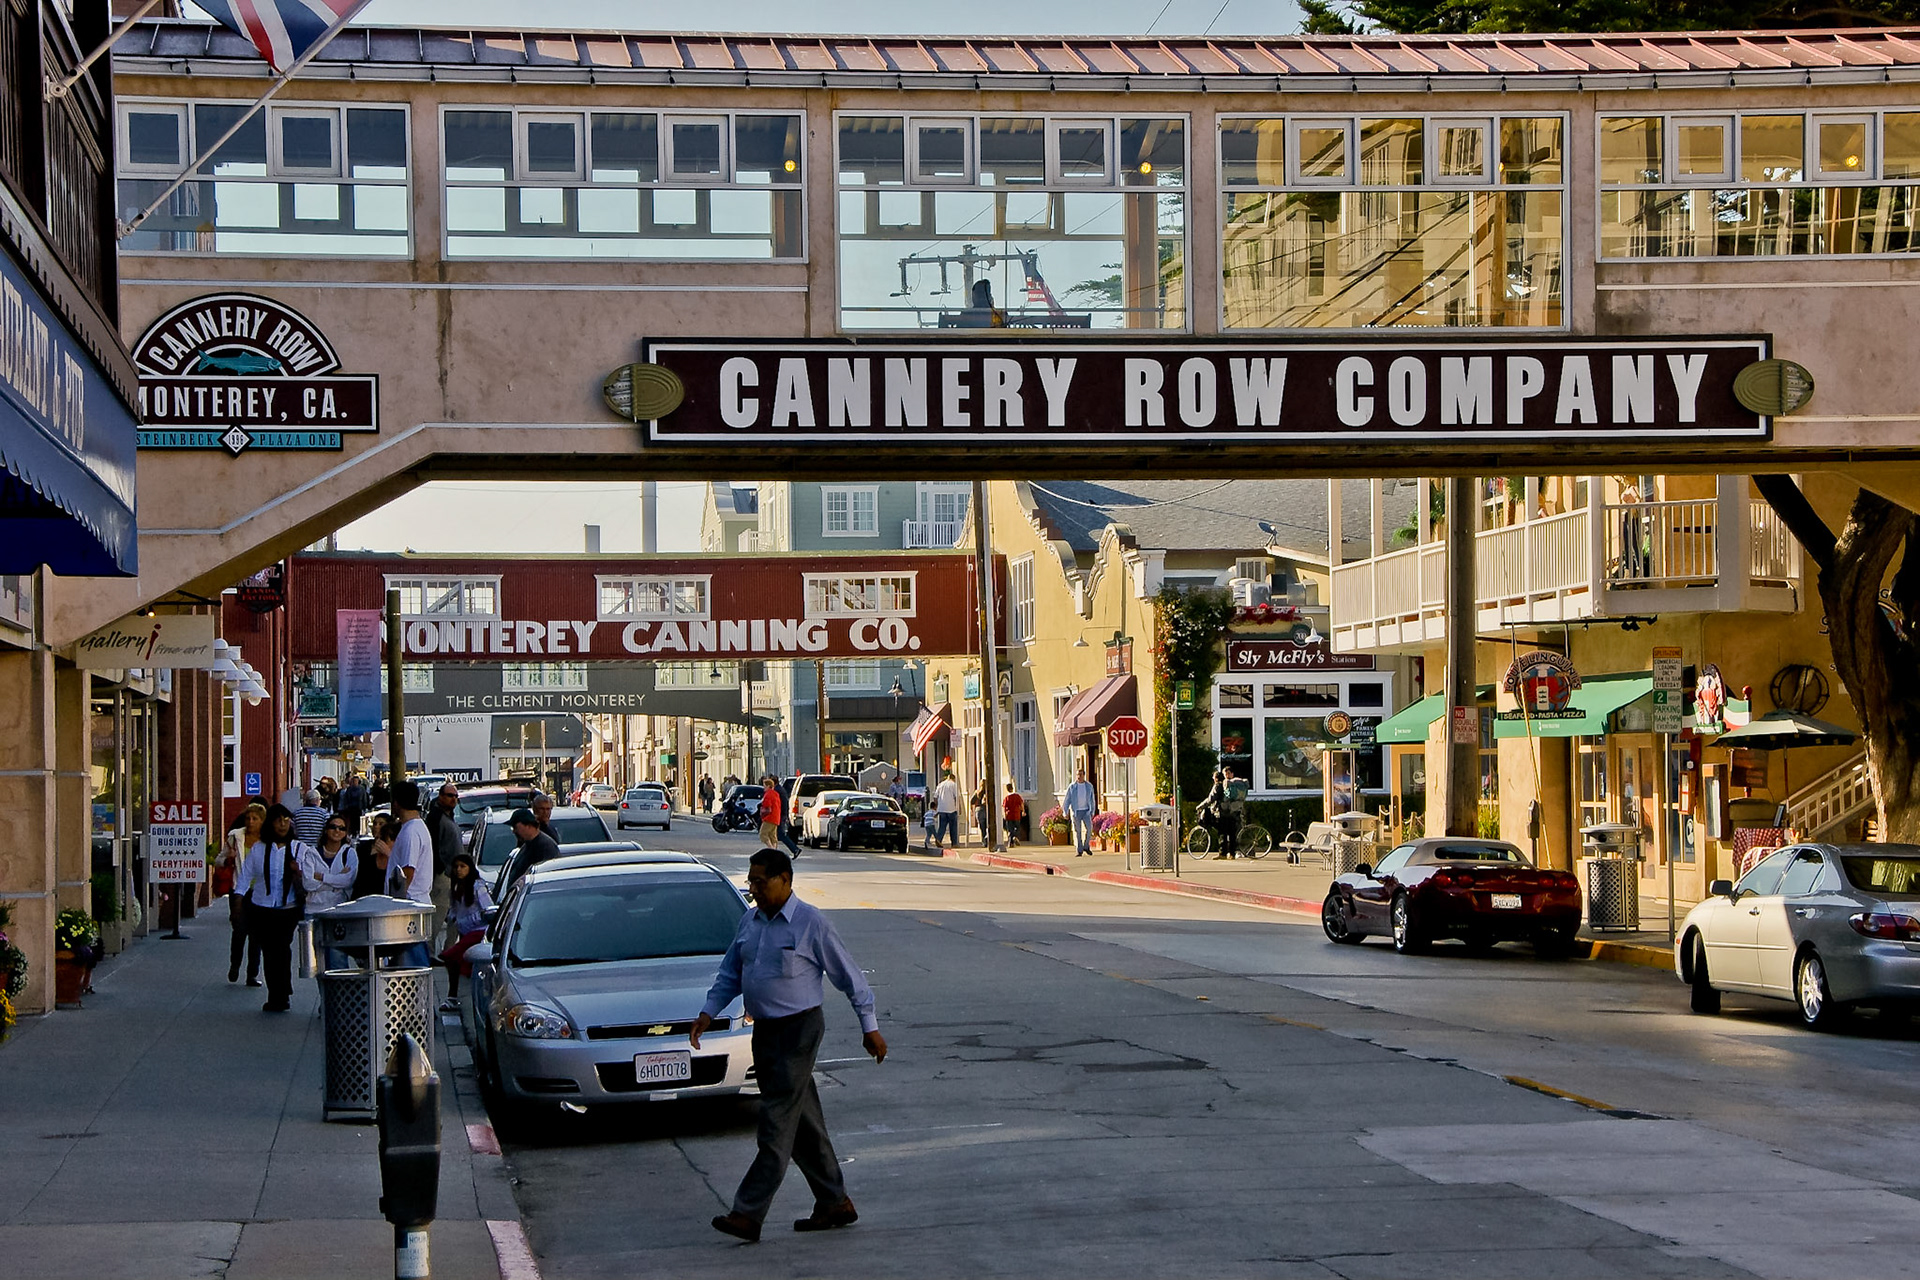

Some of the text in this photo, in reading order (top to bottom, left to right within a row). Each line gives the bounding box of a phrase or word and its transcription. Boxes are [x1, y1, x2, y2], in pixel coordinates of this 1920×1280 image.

[149, 306, 323, 373] CANNERY ROW
[719, 354, 1708, 428] CANNERY ROW COMPANY
[64, 350, 84, 451] PUB
[303, 387, 348, 419] CA.
[136, 434, 213, 446] STEINBECK
[227, 433, 244, 446] 1996
[260, 433, 336, 446] PLAZA ONE
[622, 618, 829, 654] CANNING
[849, 617, 920, 651] CO.
[153, 643, 180, 655] fine
[183, 644, 208, 655] art
[1237, 649, 1357, 667] Sly McFly's Station
[446, 694, 646, 708] THE CLEMENT MONTEREY
[1657, 692, 1664, 703] 2
[1654, 705, 1680, 714] PARKING
[437, 716, 484, 724] AQUARIUM
[1110, 729, 1145, 746] STOP
[153, 804, 203, 821] SALE
[152, 827, 205, 836] GOING OUT OF
[158, 837, 199, 847] BUSINESS
[153, 860, 203, 869] EVERYTHING
[158, 870, 197, 879] MUST GO
[640, 1062, 688, 1079] 6HOT078
